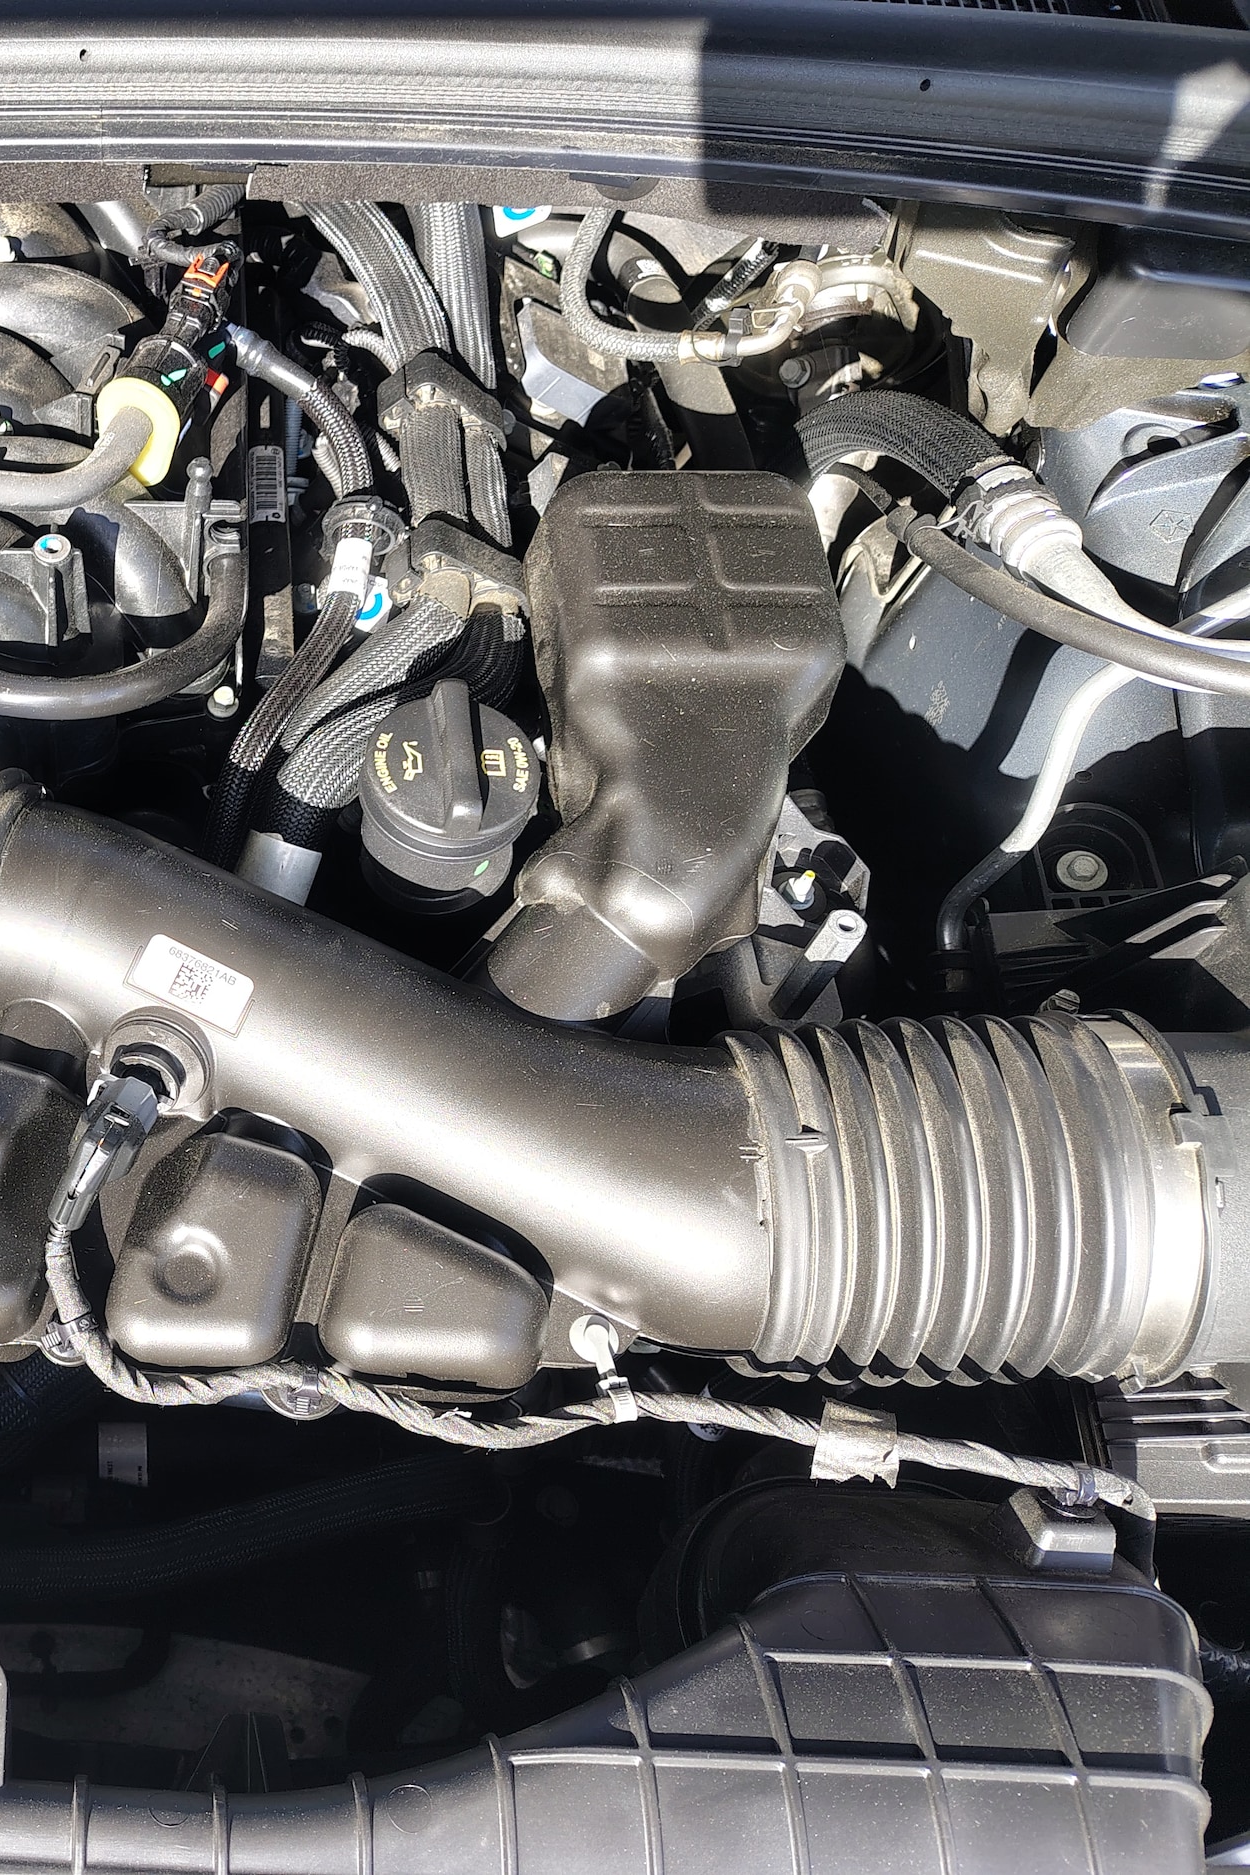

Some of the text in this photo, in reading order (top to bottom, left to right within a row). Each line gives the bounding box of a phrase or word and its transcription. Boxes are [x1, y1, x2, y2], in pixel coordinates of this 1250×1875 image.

[373, 732, 398, 794] ENGINE OIL
[506, 736, 529, 792] SAE 0W-20
[168, 946, 237, 986] 68376821AB
